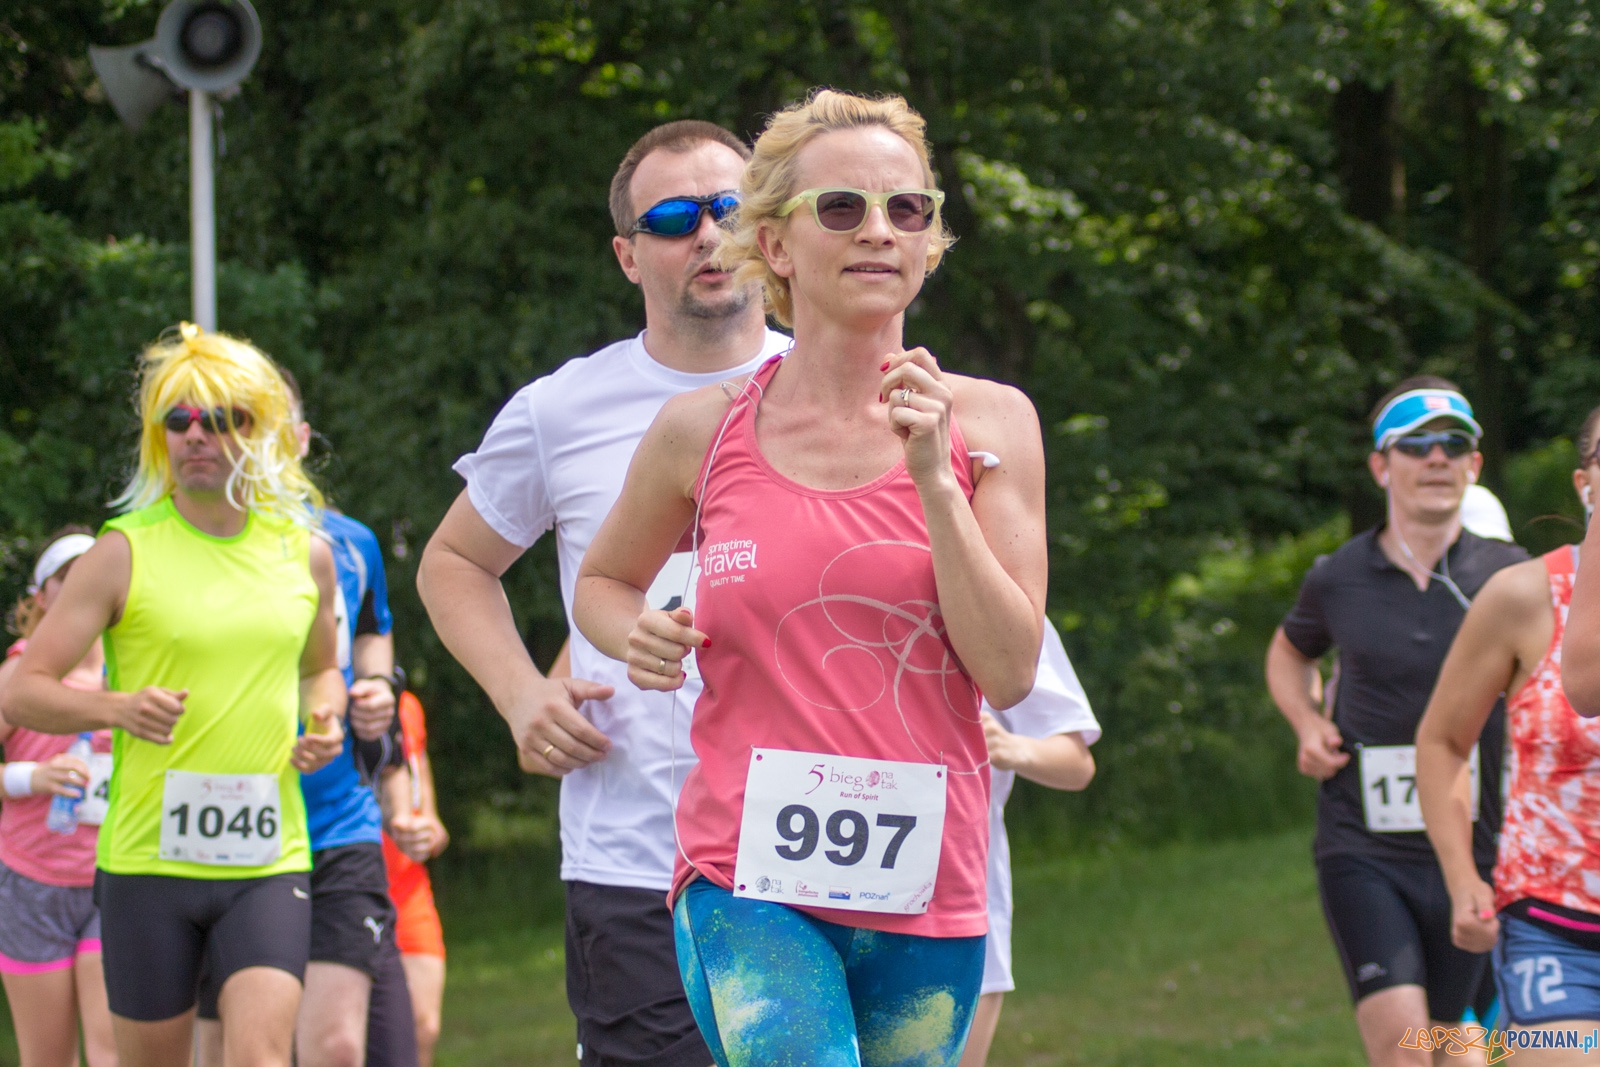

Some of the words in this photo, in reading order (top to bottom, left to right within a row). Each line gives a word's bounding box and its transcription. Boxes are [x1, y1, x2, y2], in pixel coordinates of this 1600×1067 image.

[704, 543, 758, 577] travel
[708, 539, 753, 555] springtime
[710, 577, 730, 588] QUALITY
[730, 574, 746, 583] TIME
[804, 764, 825, 795] 5
[829, 766, 864, 792] bieg
[881, 771, 894, 780] na
[881, 779, 899, 790] tak
[1371, 775, 1418, 805] 17
[839, 791, 853, 799] Run
[861, 793, 879, 801] Spirit
[169, 802, 278, 839] 1046
[774, 804, 917, 870] 997
[1513, 956, 1568, 1012] 72
